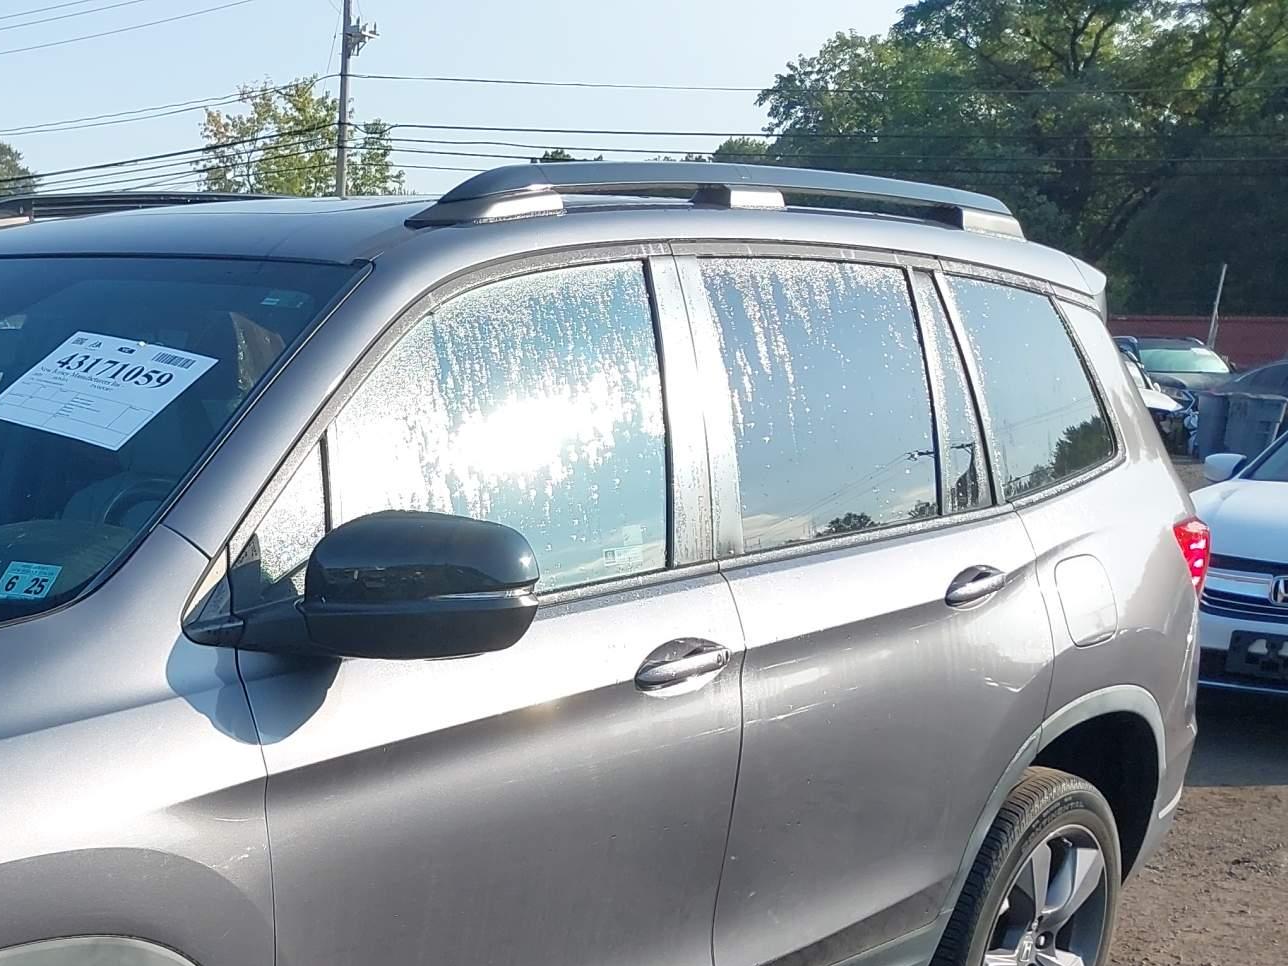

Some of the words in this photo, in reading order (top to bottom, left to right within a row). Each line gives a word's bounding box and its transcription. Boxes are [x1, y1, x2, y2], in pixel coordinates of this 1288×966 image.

[56, 352, 174, 389] 43171059
[5, 575, 19, 592] 6
[23, 577, 49, 595] 25
